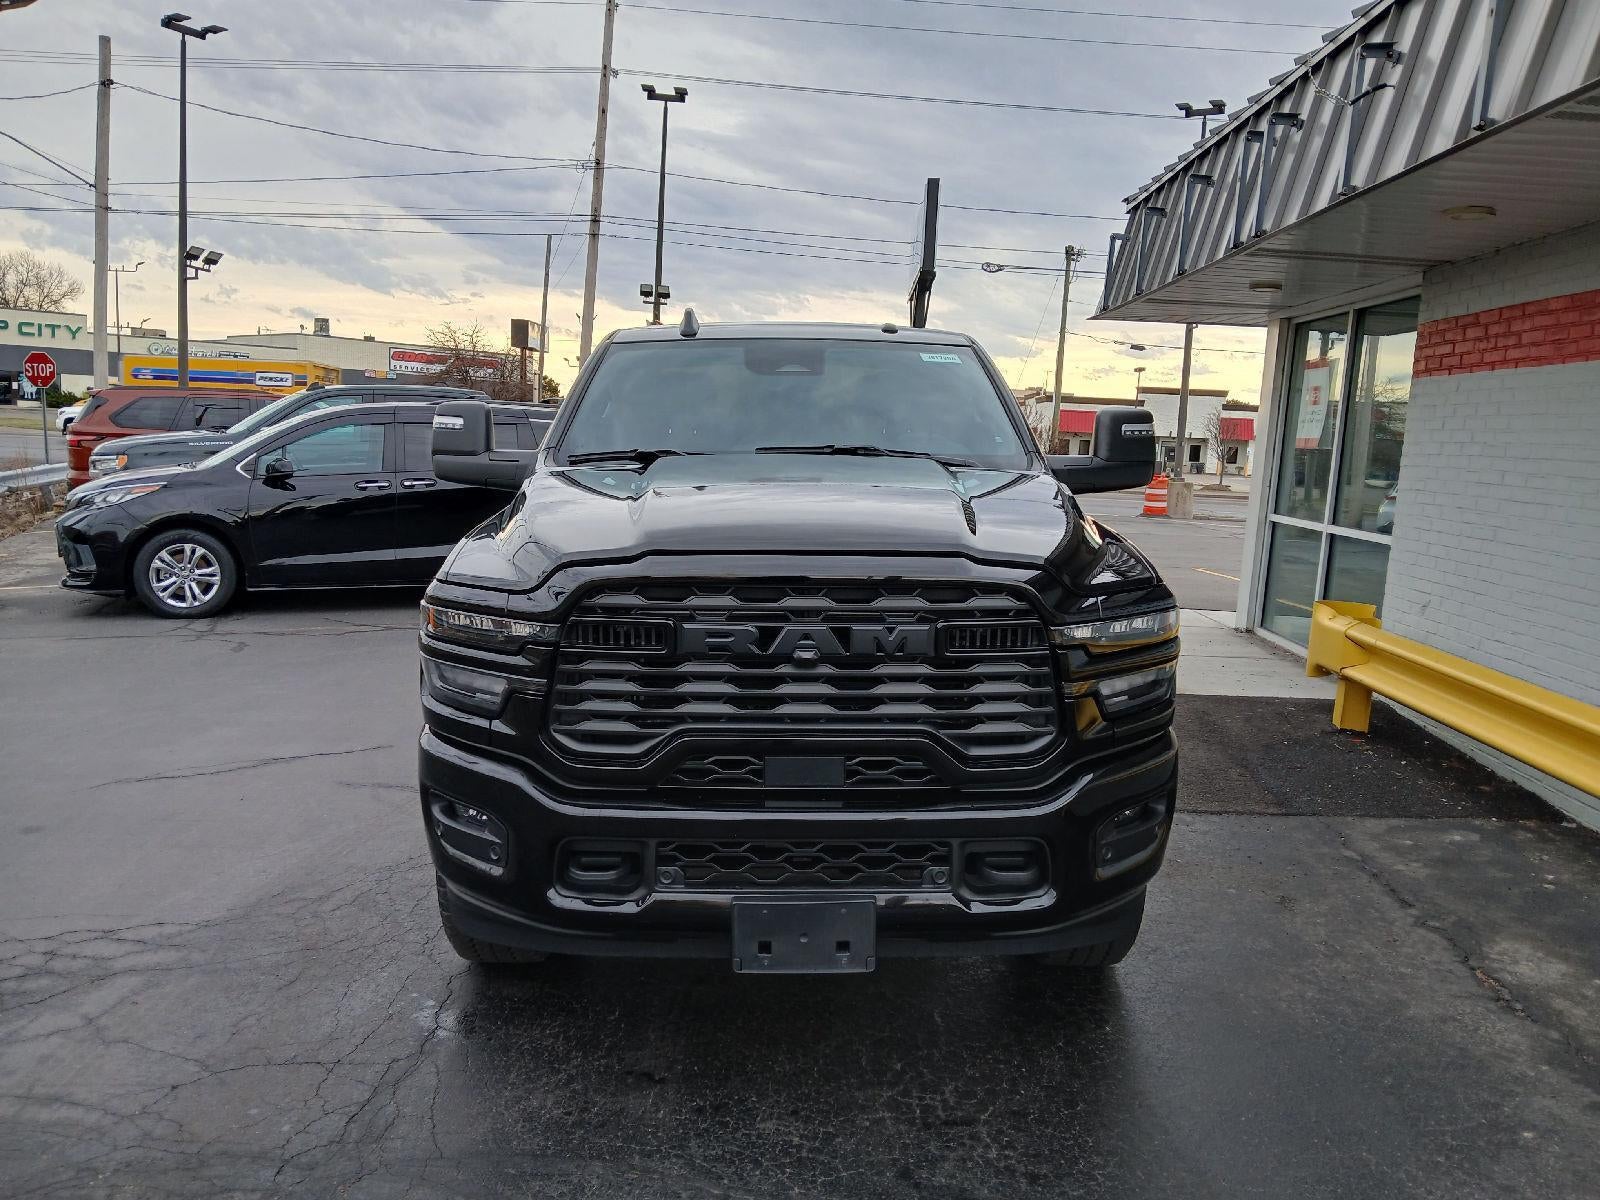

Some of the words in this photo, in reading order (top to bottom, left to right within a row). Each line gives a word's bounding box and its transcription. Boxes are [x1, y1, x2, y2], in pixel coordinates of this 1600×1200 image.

[18, 321, 83, 340] CITY
[25, 363, 54, 377] STOP
[681, 623, 935, 656] RAM
